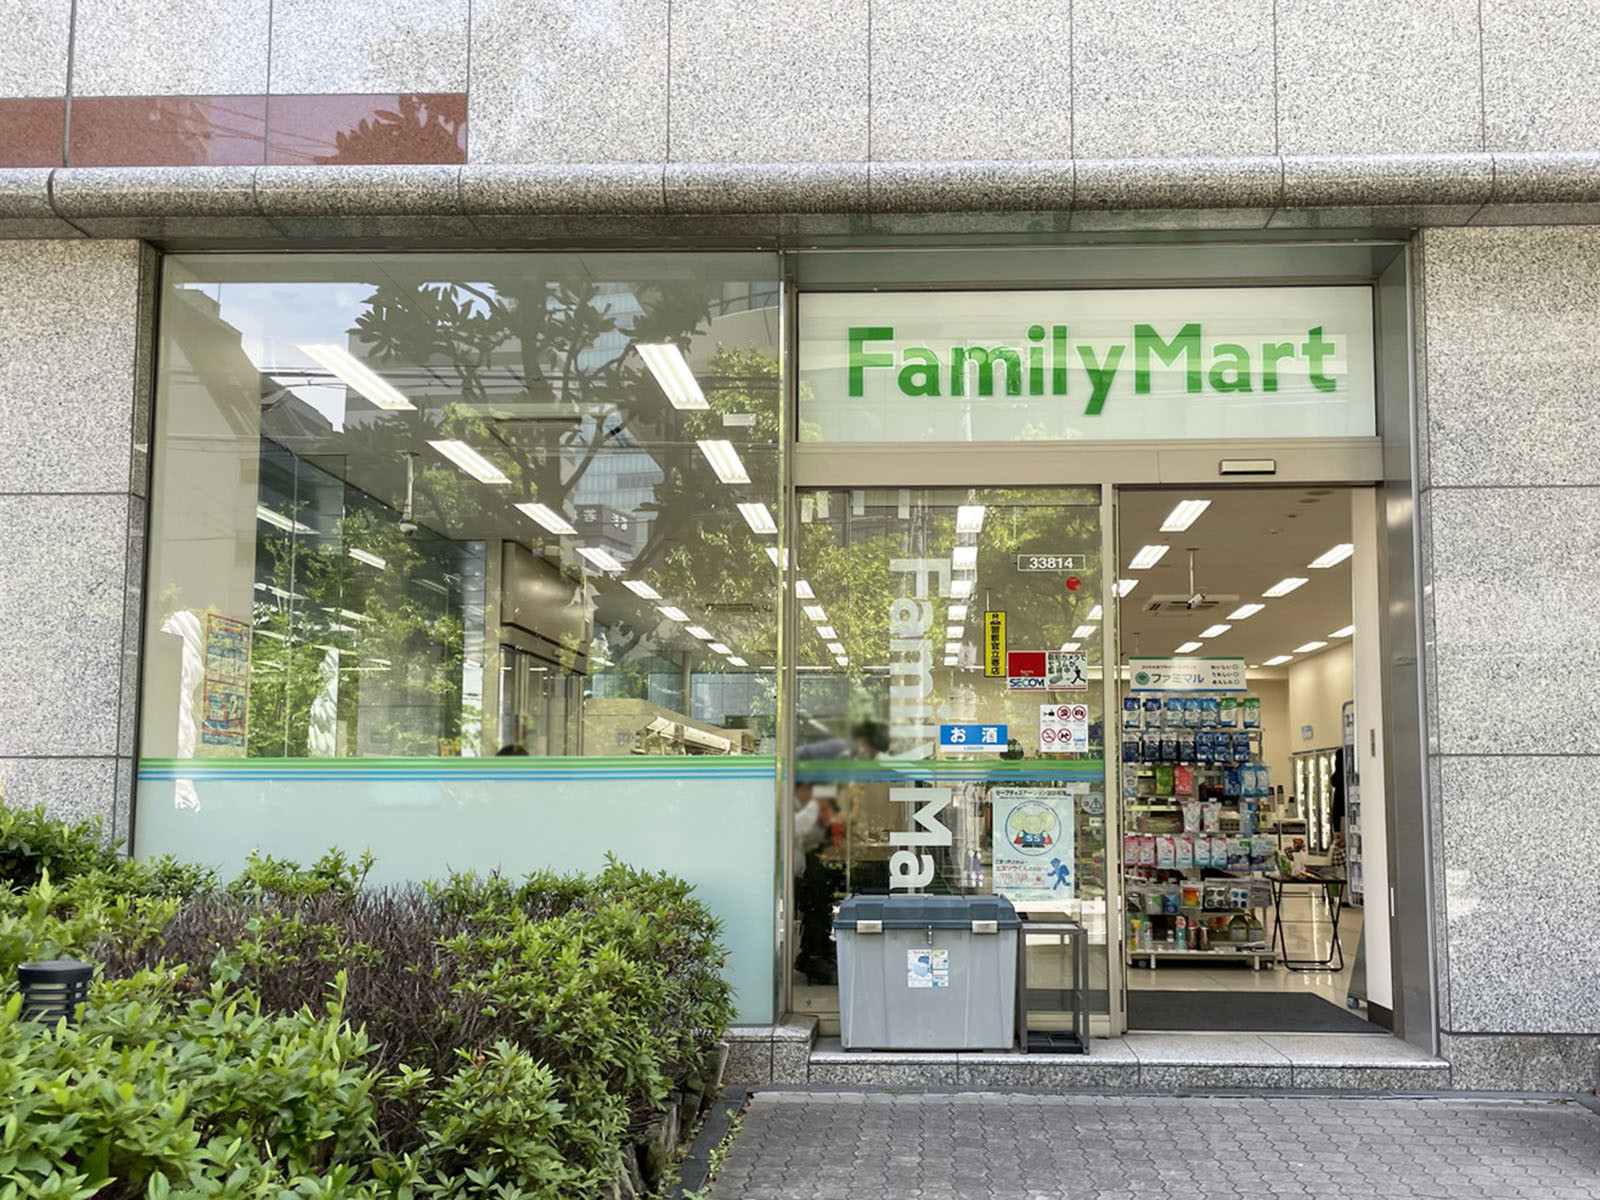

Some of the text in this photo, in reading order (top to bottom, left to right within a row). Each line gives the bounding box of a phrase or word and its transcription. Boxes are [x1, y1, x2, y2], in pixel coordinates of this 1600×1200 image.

[848, 323, 1338, 416] FamilyMart
[1029, 557, 1073, 569] 33814
[1009, 678, 1045, 687] SECOM
[1151, 673, 1204, 683] ファミマル
[877, 558, 952, 896] FamilyMa
[950, 727, 998, 743] お酒
